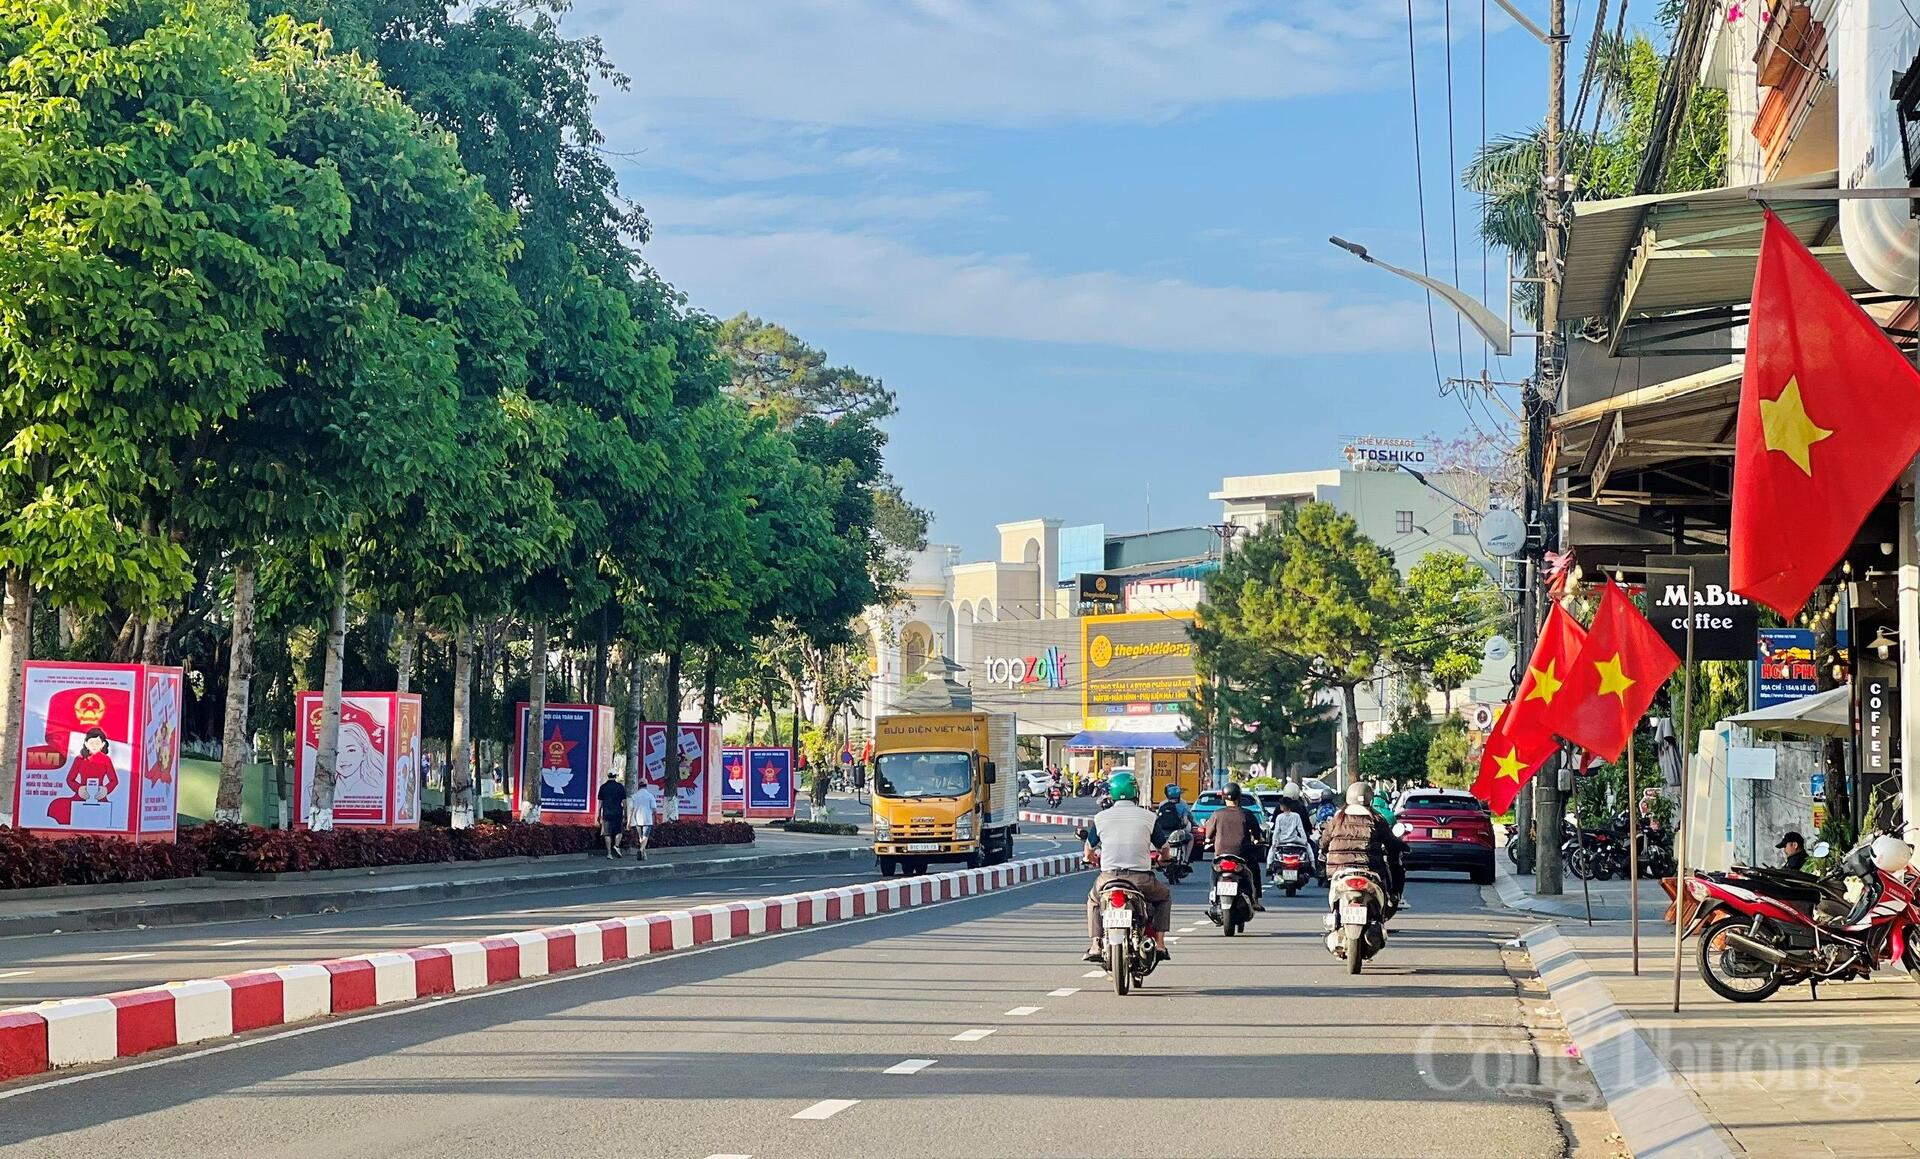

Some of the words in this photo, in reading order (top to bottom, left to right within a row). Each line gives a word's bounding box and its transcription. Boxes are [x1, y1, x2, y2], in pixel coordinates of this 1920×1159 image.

[1376, 439, 1416, 447] MASSAGE
[1358, 448, 1424, 462] TOSHIKO
[934, 725, 956, 733] VIỆT
[1870, 683, 1882, 767] COFFEE
[27, 751, 60, 766] XVI
